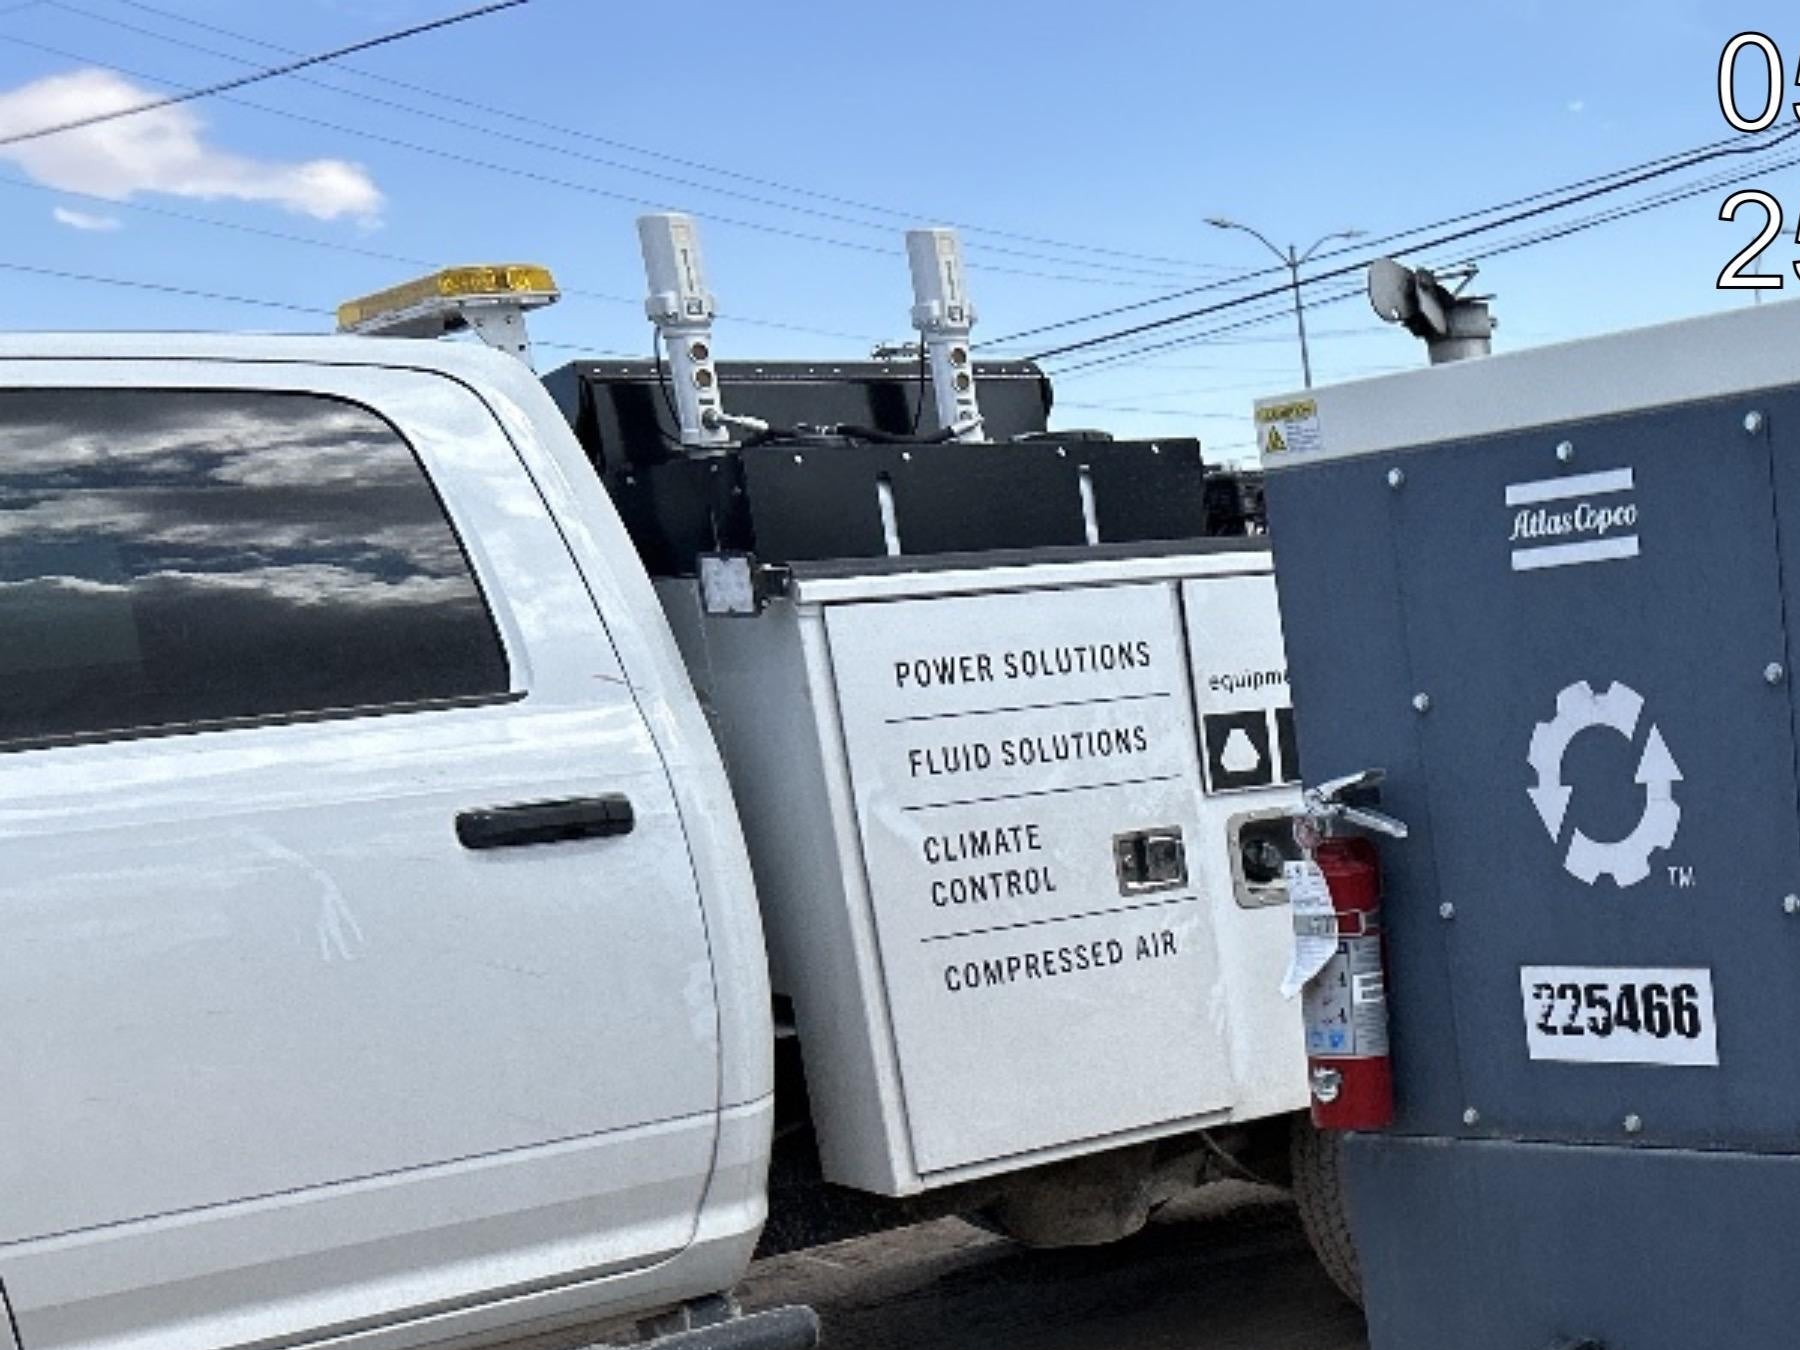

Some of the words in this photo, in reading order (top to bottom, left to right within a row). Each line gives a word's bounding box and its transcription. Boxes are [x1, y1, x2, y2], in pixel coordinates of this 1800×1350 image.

[894, 654, 995, 688] POWER
[1003, 640, 1152, 679] SOLUTIONS
[908, 743, 991, 777] FLUID
[1001, 725, 1149, 767] SOLUTIONS
[923, 824, 1043, 864] CLIMATE
[931, 866, 1057, 907] CONTROL
[944, 940, 1123, 992] COMPRESSED
[1135, 930, 1178, 961] AIR
[1532, 983, 1702, 1039] 225466
